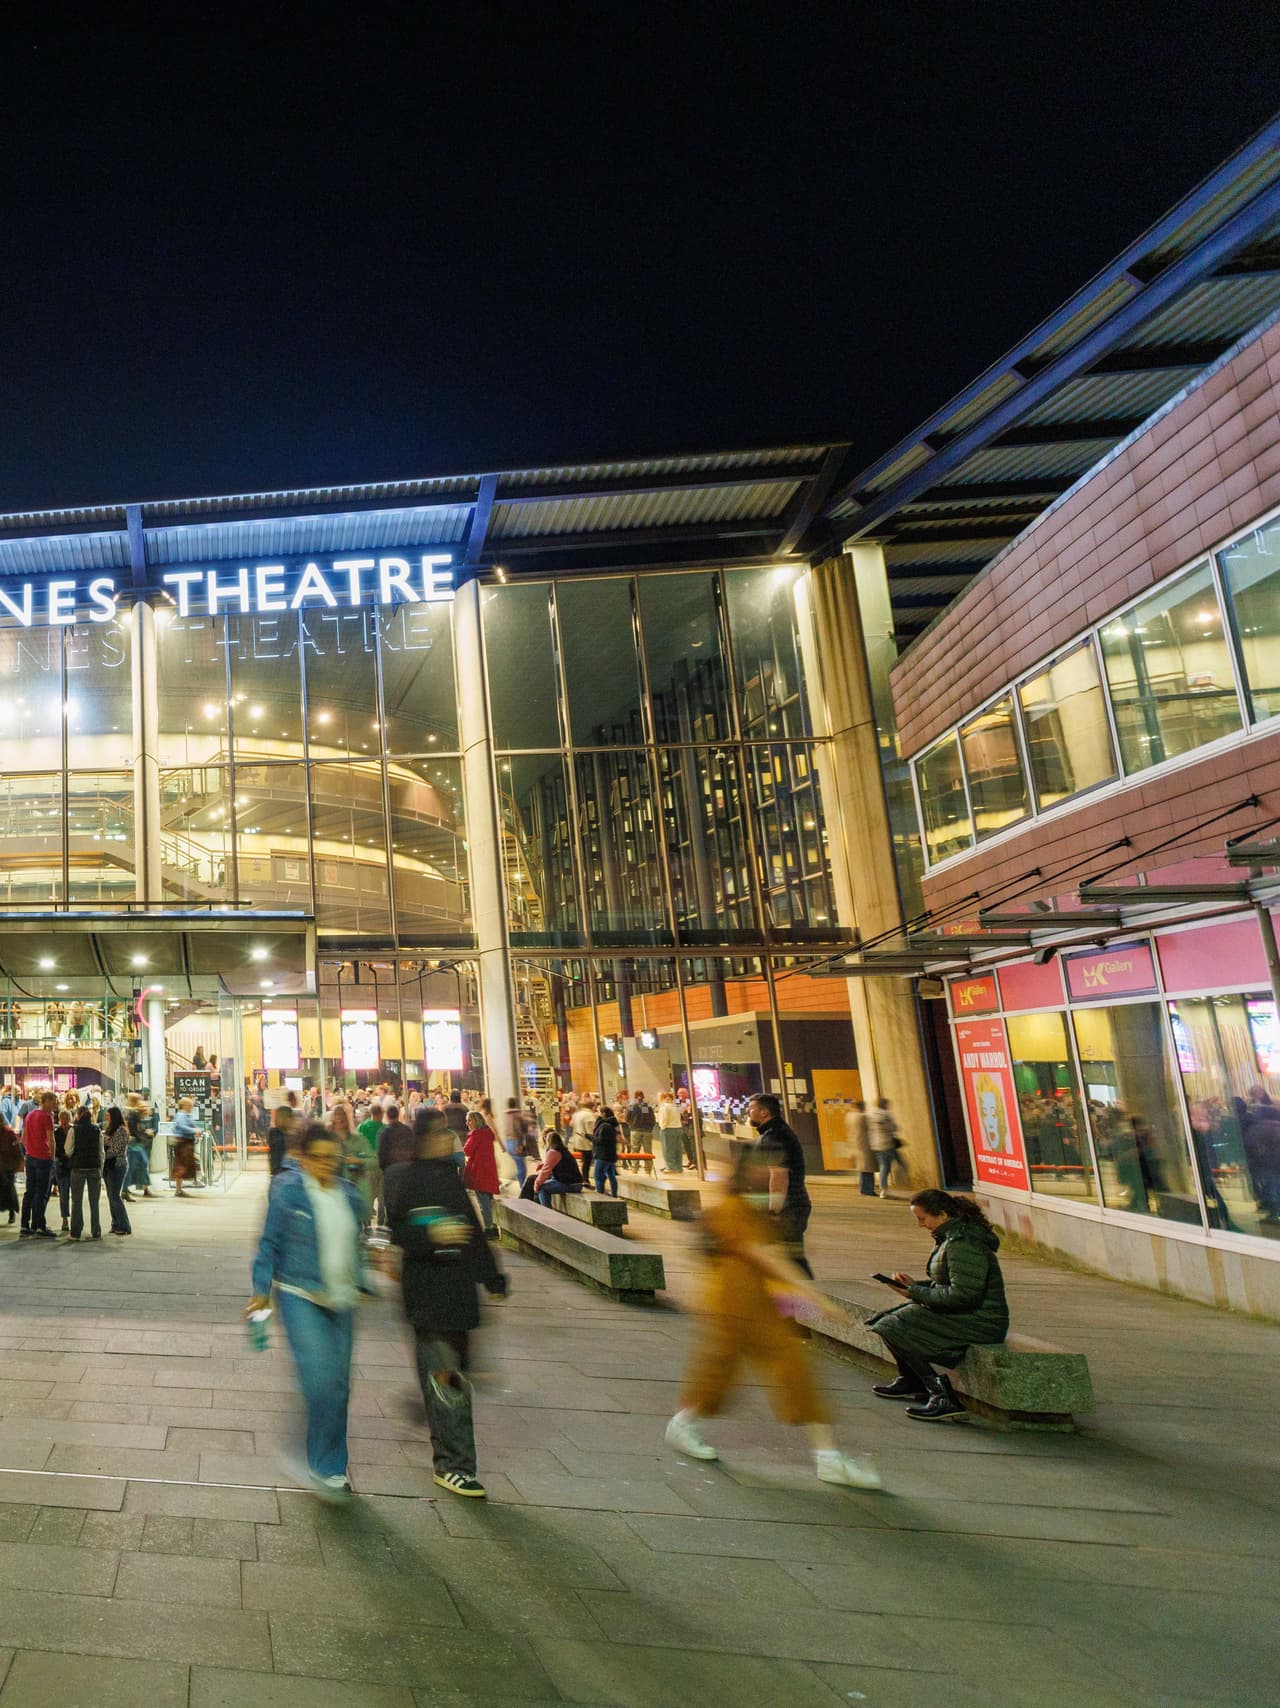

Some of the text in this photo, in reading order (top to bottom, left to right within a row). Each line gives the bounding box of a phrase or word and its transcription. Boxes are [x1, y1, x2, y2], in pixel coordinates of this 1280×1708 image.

[163, 553, 456, 617] THEATRE
[1104, 960, 1133, 974] Gallery
[179, 1078, 206, 1087] SCAN
